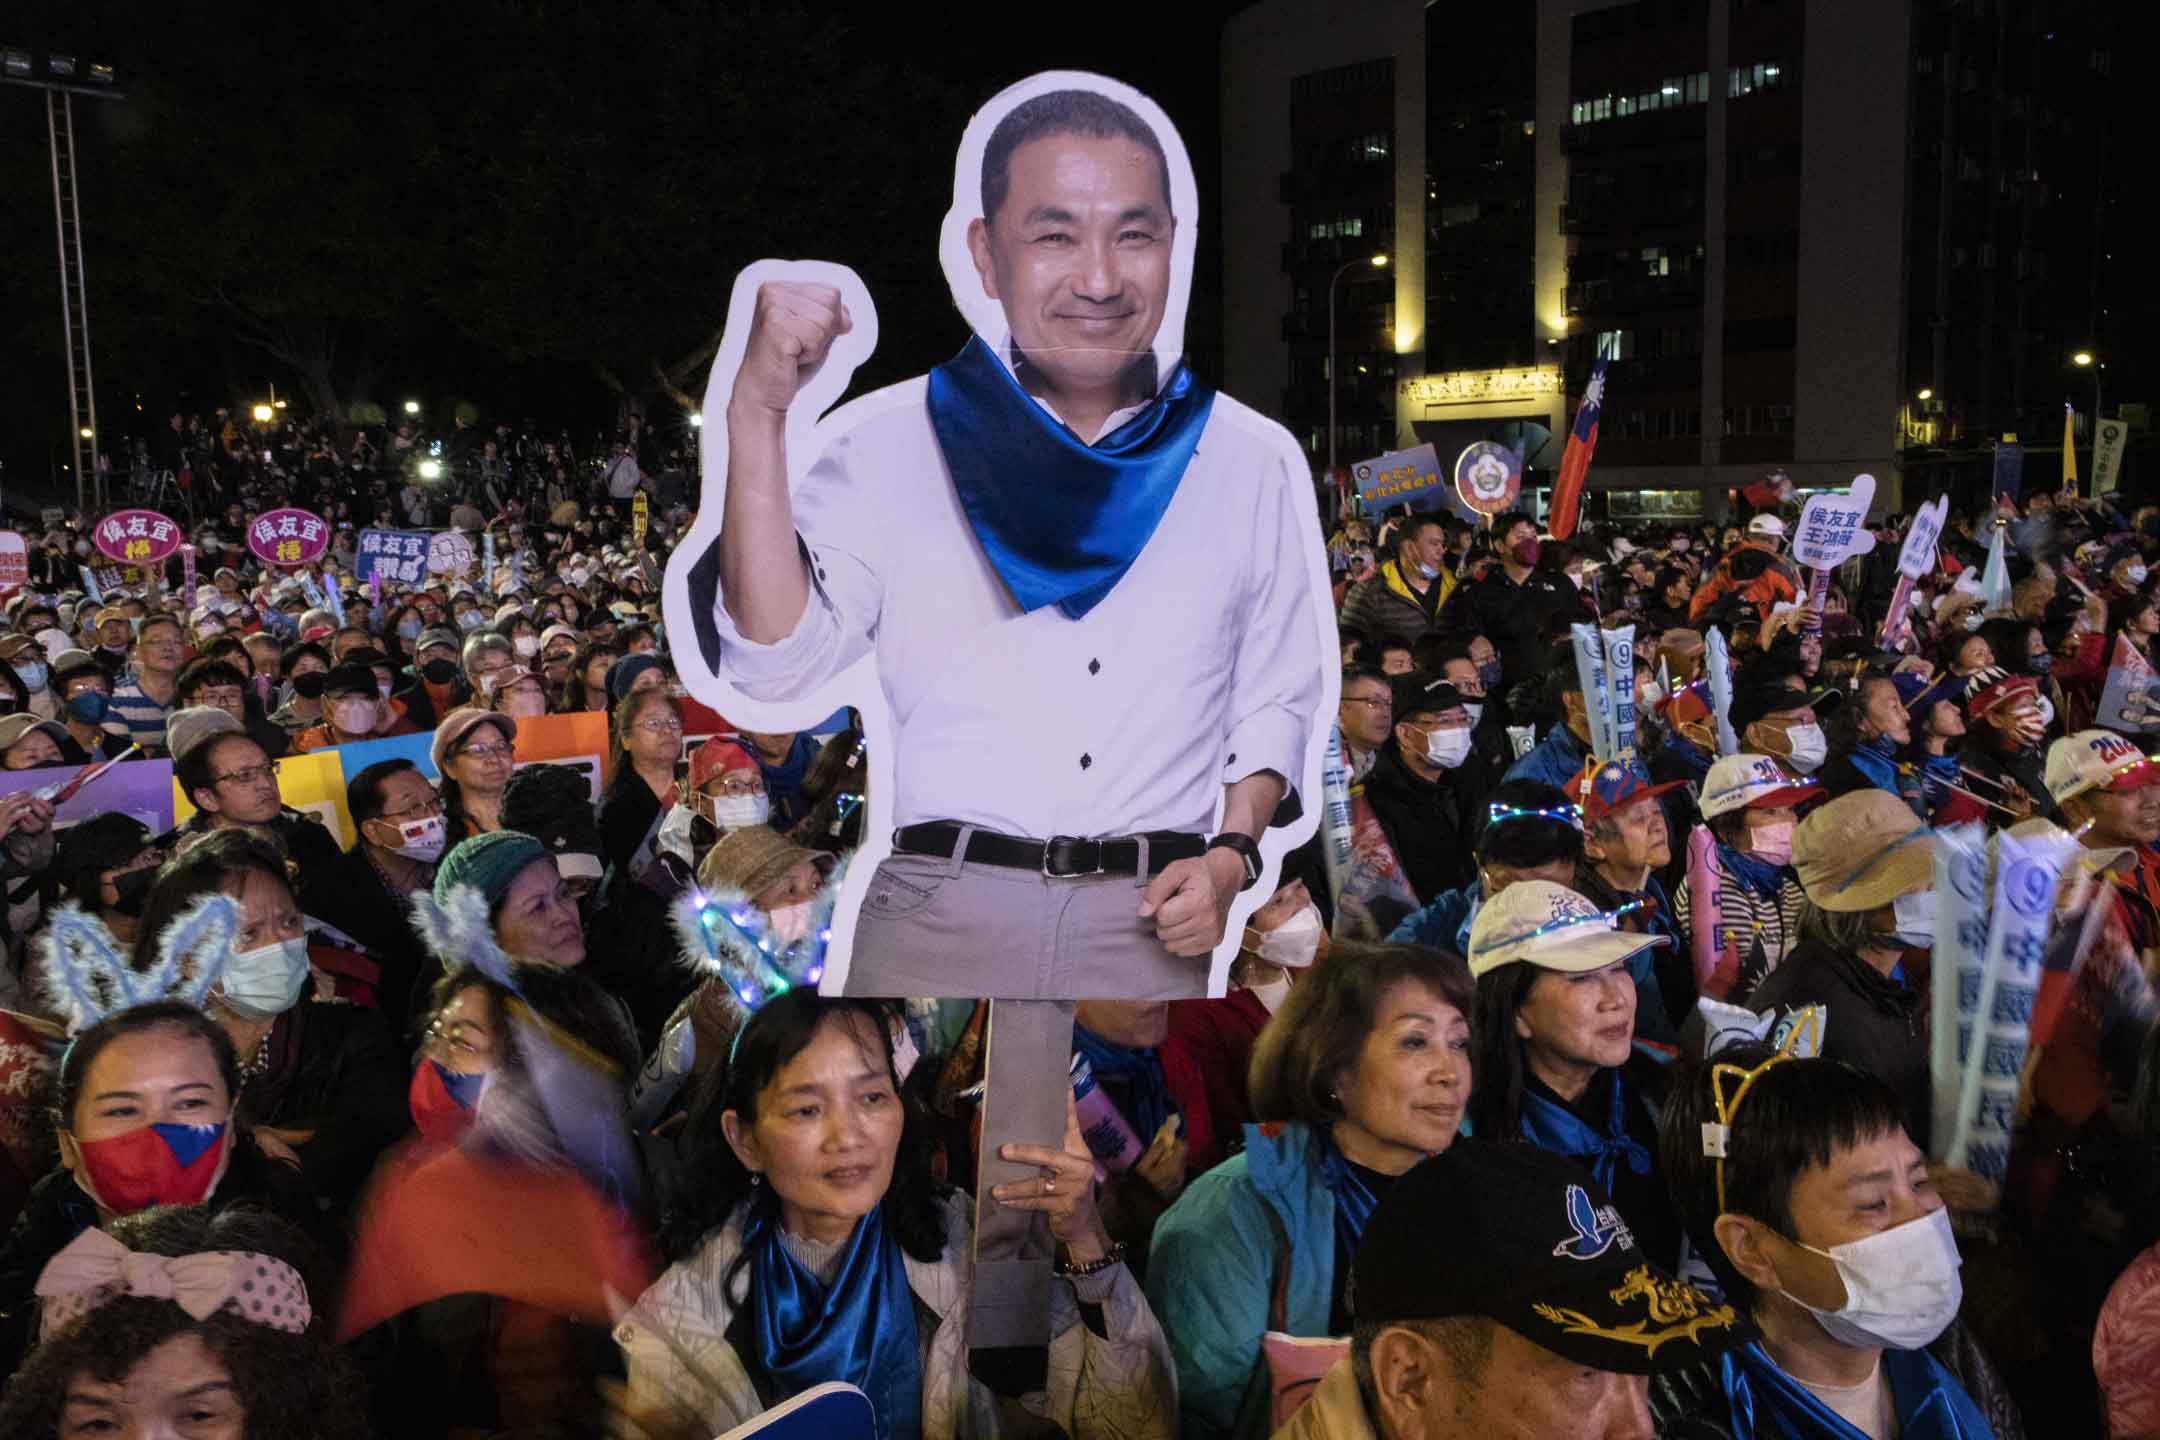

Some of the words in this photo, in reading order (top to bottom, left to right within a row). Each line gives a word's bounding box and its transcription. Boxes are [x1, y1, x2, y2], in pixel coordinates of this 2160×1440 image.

[103, 515, 173, 544] 侯友宜
[255, 515, 321, 544] 侯友宜
[1809, 507, 1861, 527] 侯友宜
[363, 533, 422, 556] 侯友宜
